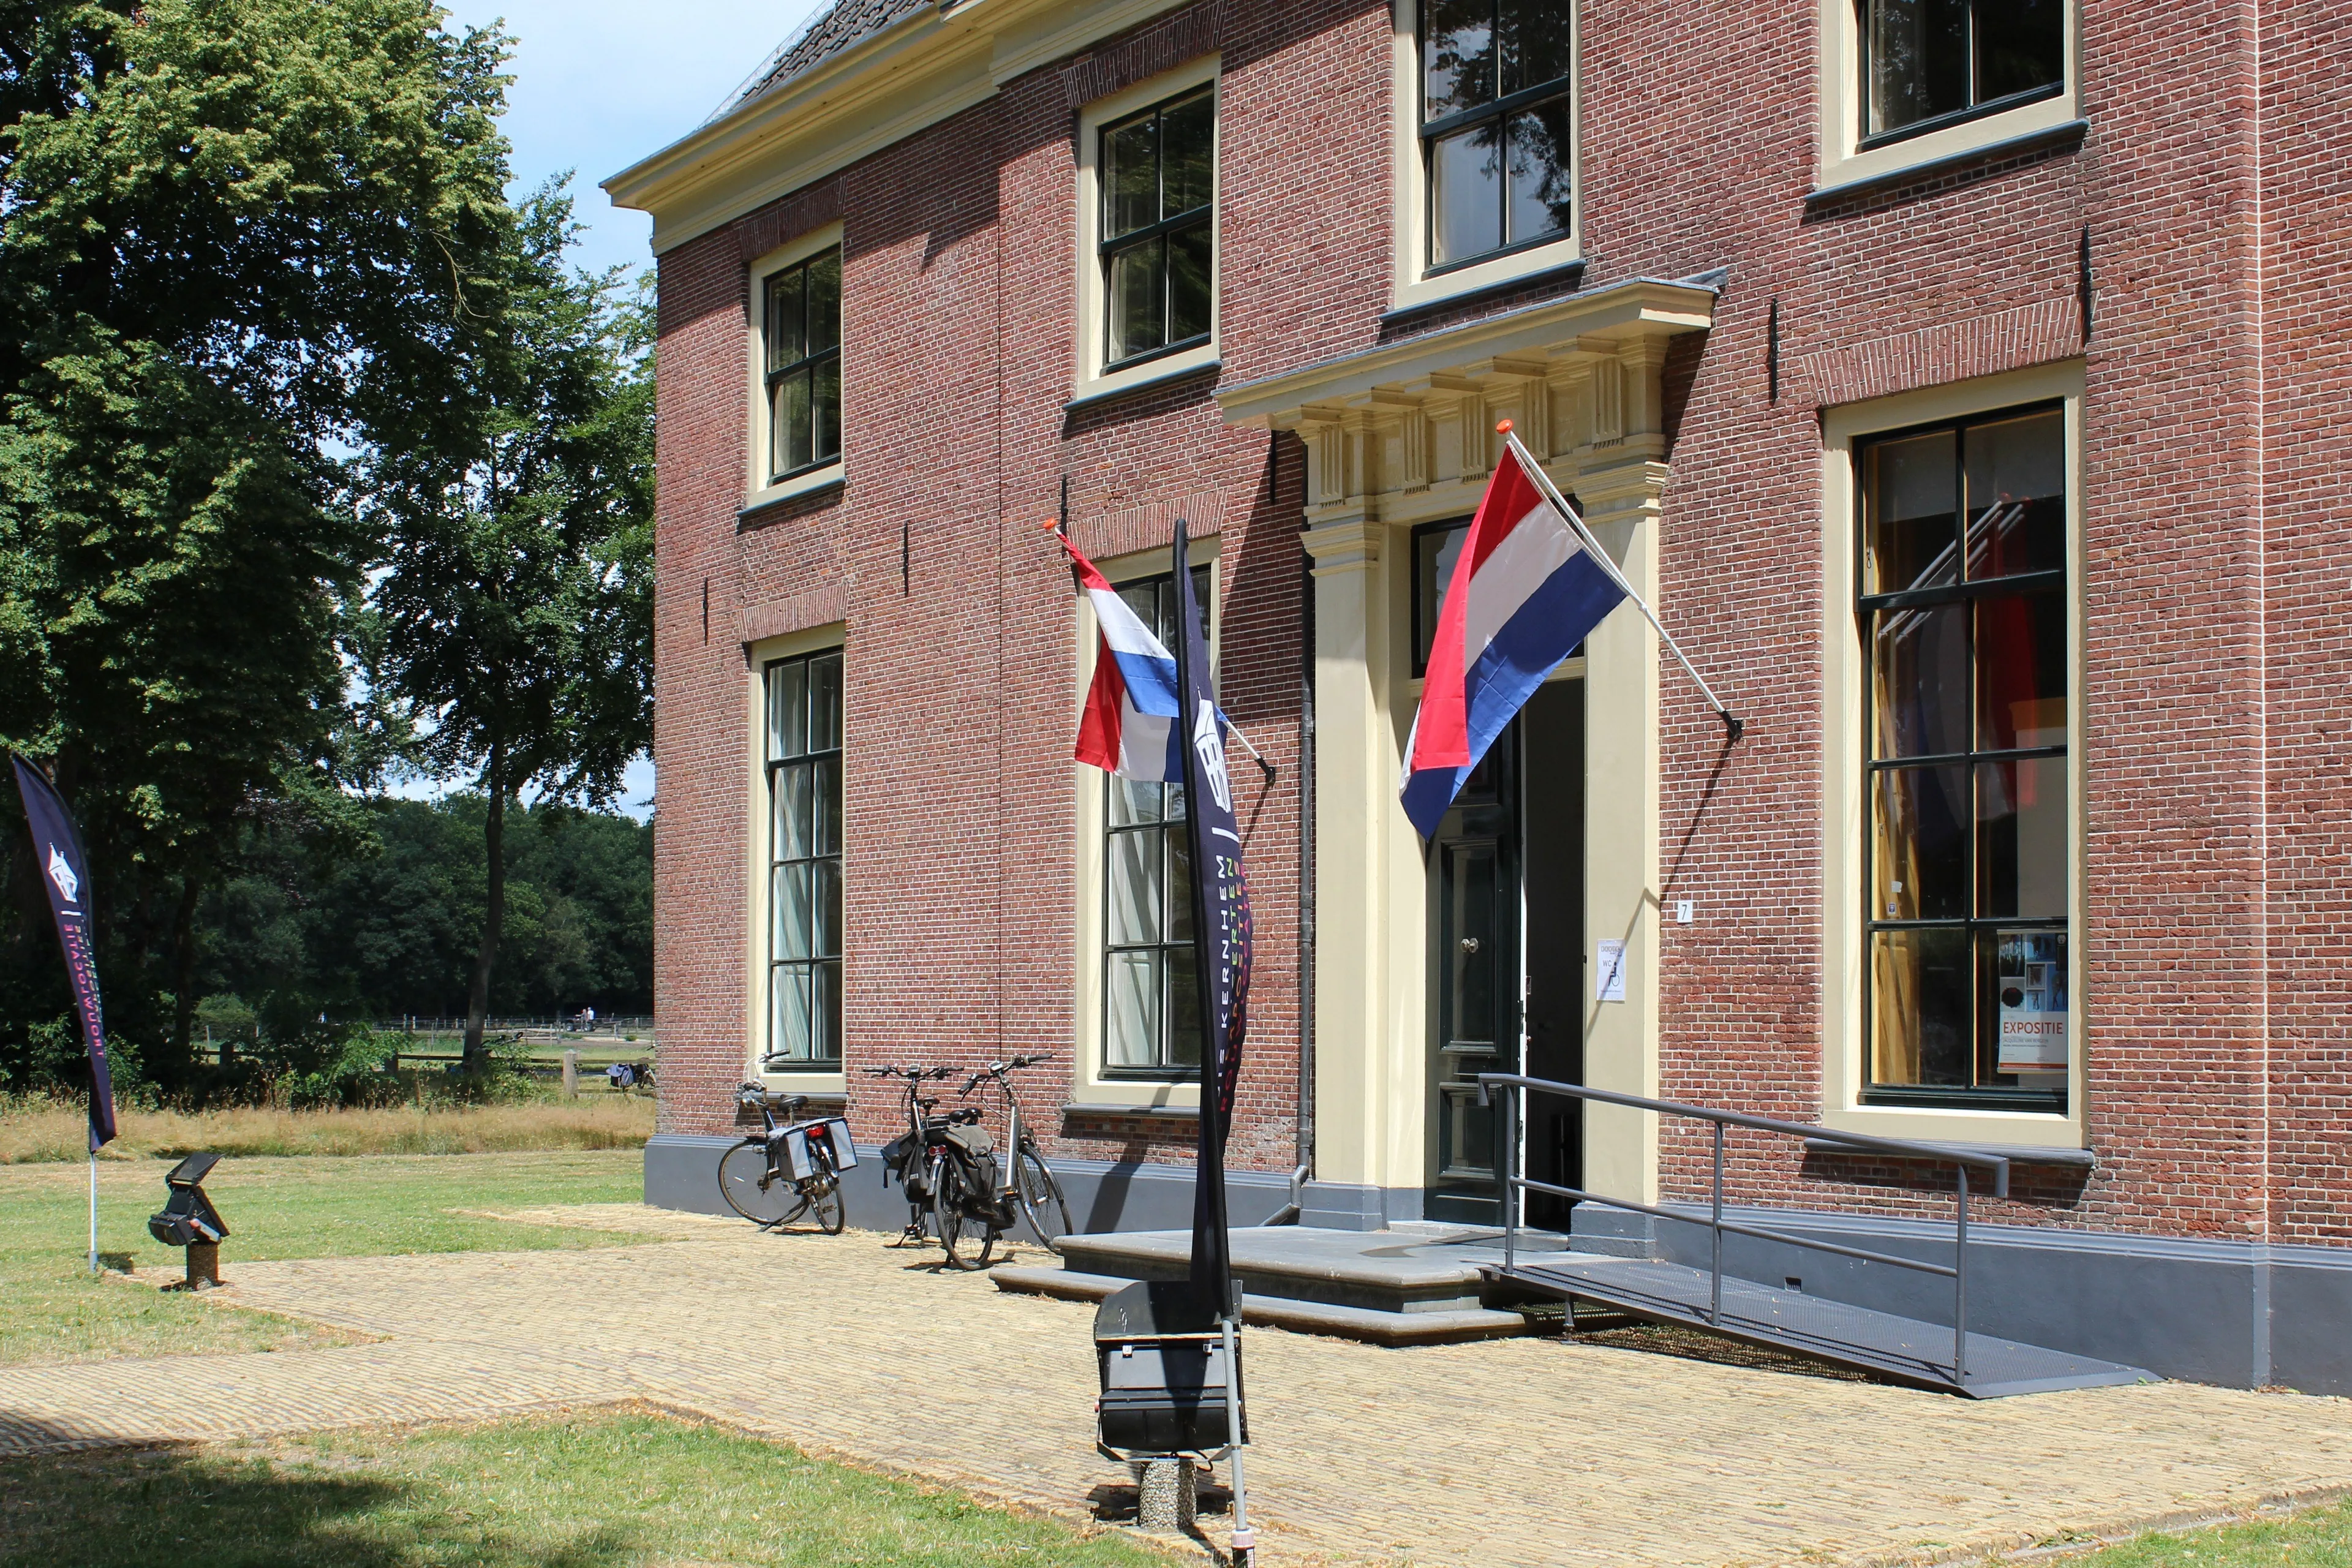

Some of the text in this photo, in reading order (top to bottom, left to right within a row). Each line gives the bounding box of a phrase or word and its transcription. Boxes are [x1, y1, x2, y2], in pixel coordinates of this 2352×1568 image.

[1681, 904, 1687, 920] 7
[1216, 854, 1229, 1028] KERNHEM
[2003, 1022, 2063, 1034] EXPOSITIE
